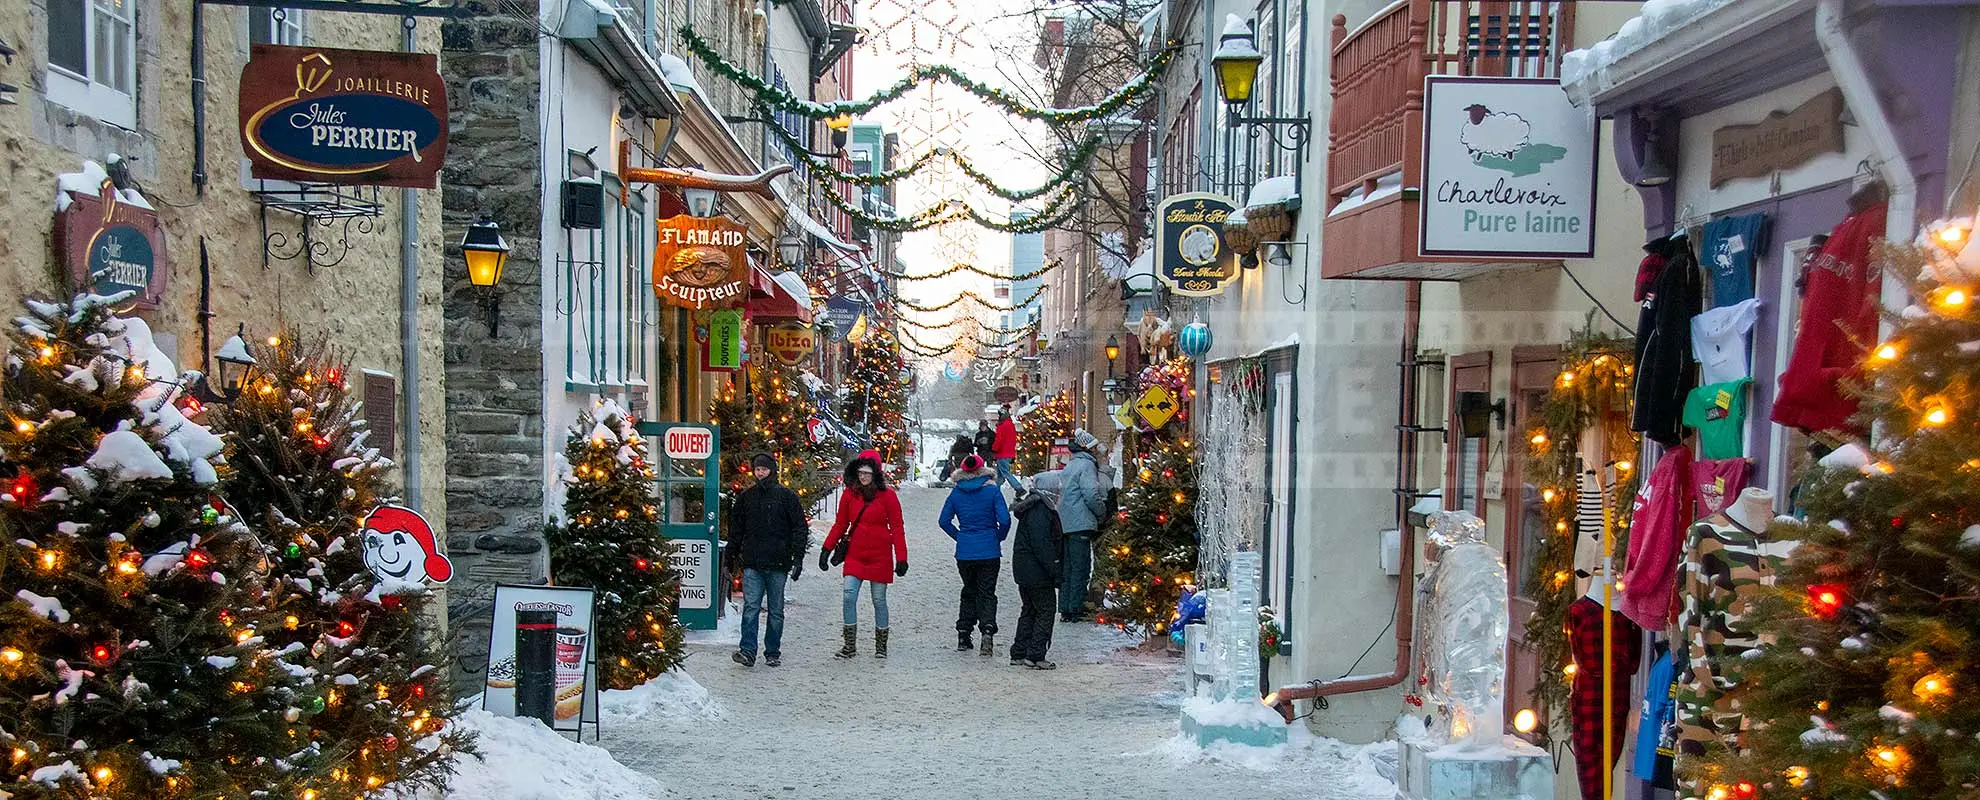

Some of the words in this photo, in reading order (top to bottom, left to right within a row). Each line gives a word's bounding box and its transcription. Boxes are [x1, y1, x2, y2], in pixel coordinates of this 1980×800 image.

[335, 77, 430, 105] JOAILLERIE
[290, 103, 347, 129] Jules
[312, 125, 422, 163] PERRIER
[1438, 177, 1566, 206] Charlevoix
[1464, 209, 1517, 233] Pure
[1525, 210, 1580, 233] laine
[101, 235, 122, 263] Jules
[661, 228, 743, 246] FLAMAND
[109, 260, 149, 299] PERRIER
[656, 275, 741, 309] Sculpteur
[770, 333, 811, 348] Ibiza
[669, 432, 710, 453] OUVERT
[671, 556, 701, 566] TURE
[691, 543, 706, 554] DE
